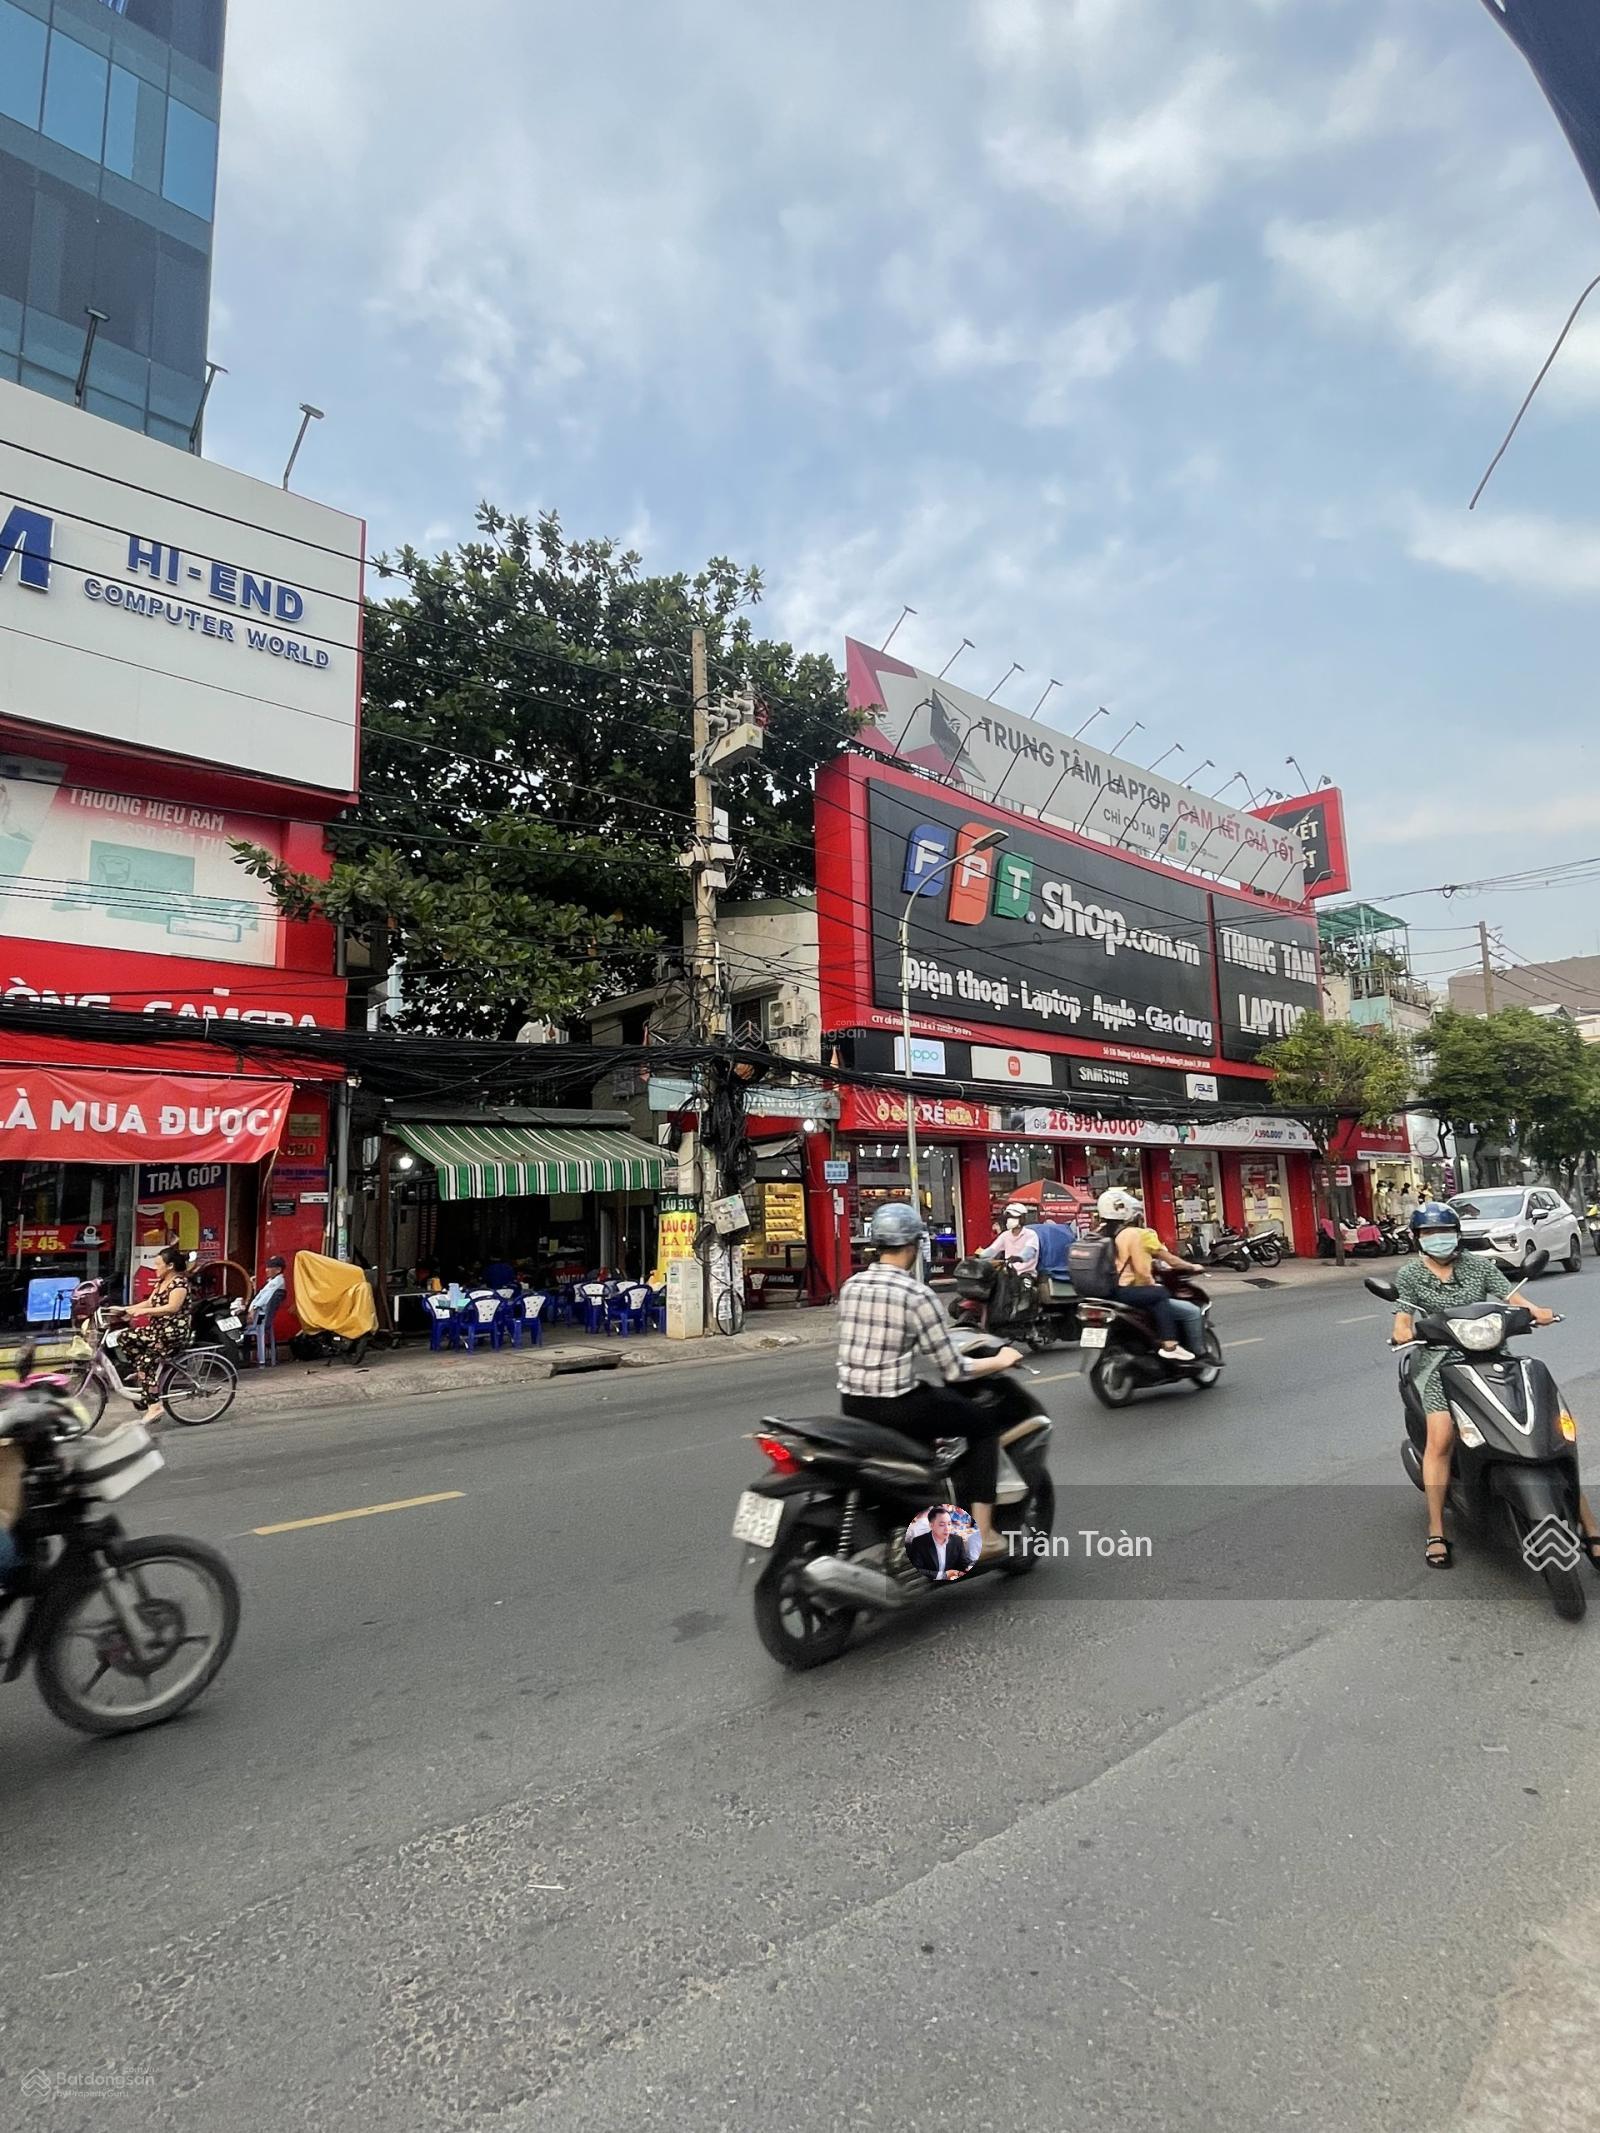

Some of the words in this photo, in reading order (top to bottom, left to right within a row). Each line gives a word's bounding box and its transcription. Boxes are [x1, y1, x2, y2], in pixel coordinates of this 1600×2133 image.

[126, 534, 304, 623] HI-END
[83, 577, 235, 642] COMPUTER
[246, 628, 330, 669] WORLD
[981, 716, 1055, 768] TRUNG
[1060, 749, 1101, 788] TÂM
[1107, 768, 1170, 813] LAPTOP
[188, 809, 225, 832] RAM
[1219, 927, 1276, 975] TRUNG
[1281, 939, 1317, 985] TÂM
[956, 961, 1009, 1010] thoại
[1020, 980, 1081, 1023] Laptop
[1093, 994, 1136, 1031] Apple
[1145, 1005, 1173, 1033] Gia
[1174, 1009, 1213, 1047] dụng
[910, 1049, 940, 1062] ppo
[1079, 1066, 1129, 1085] SAMSUNG
[0, 1088, 37, 1130] À
[50, 1099, 147, 1134] MUA
[159, 1106, 282, 1143] ĐƯỢC!
[147, 1164, 183, 1193] TRẢ
[187, 1163, 222, 1188] GÓP
